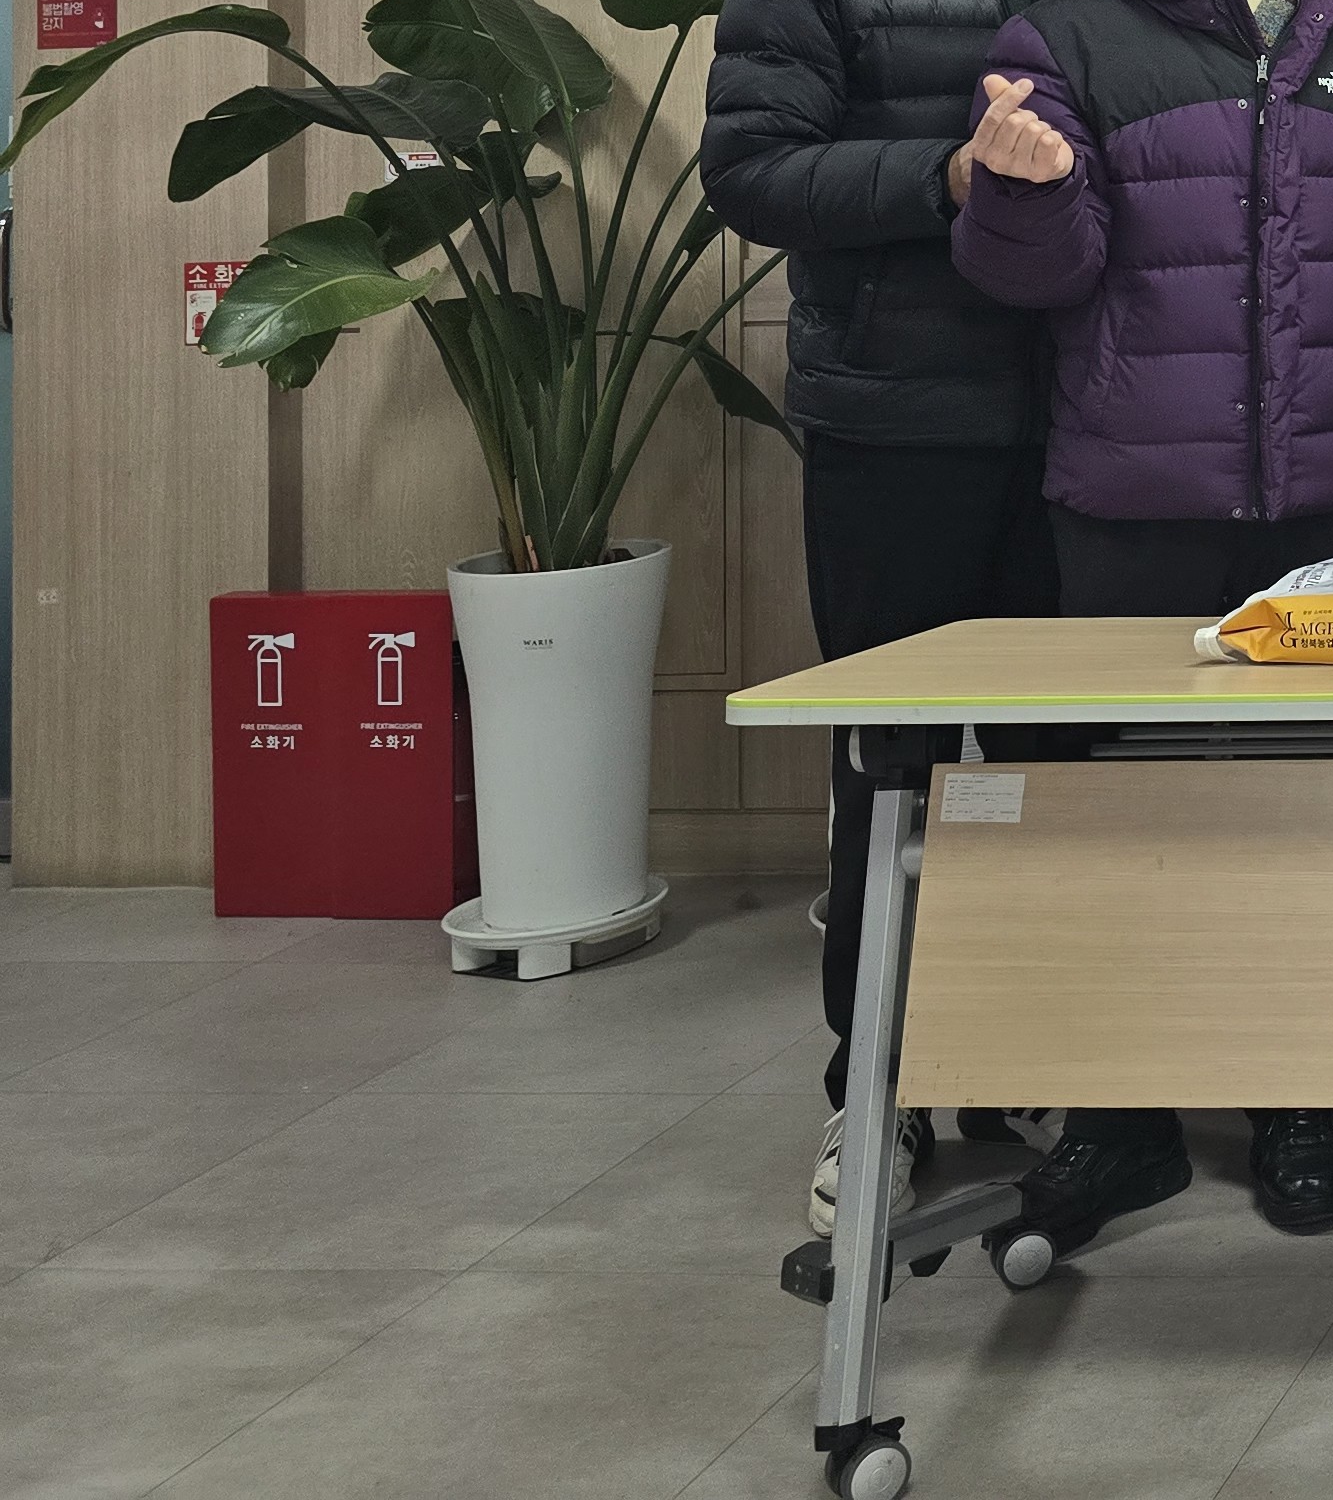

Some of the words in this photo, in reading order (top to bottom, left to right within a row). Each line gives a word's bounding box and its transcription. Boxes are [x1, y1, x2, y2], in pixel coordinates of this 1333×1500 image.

[42, 1, 84, 16] 불법촬영
[241, 723, 255, 731] FIRE
[257, 723, 303, 731] EXTINGUISHER
[250, 735, 295, 749] 소화기
[369, 734, 415, 749] 소화기
